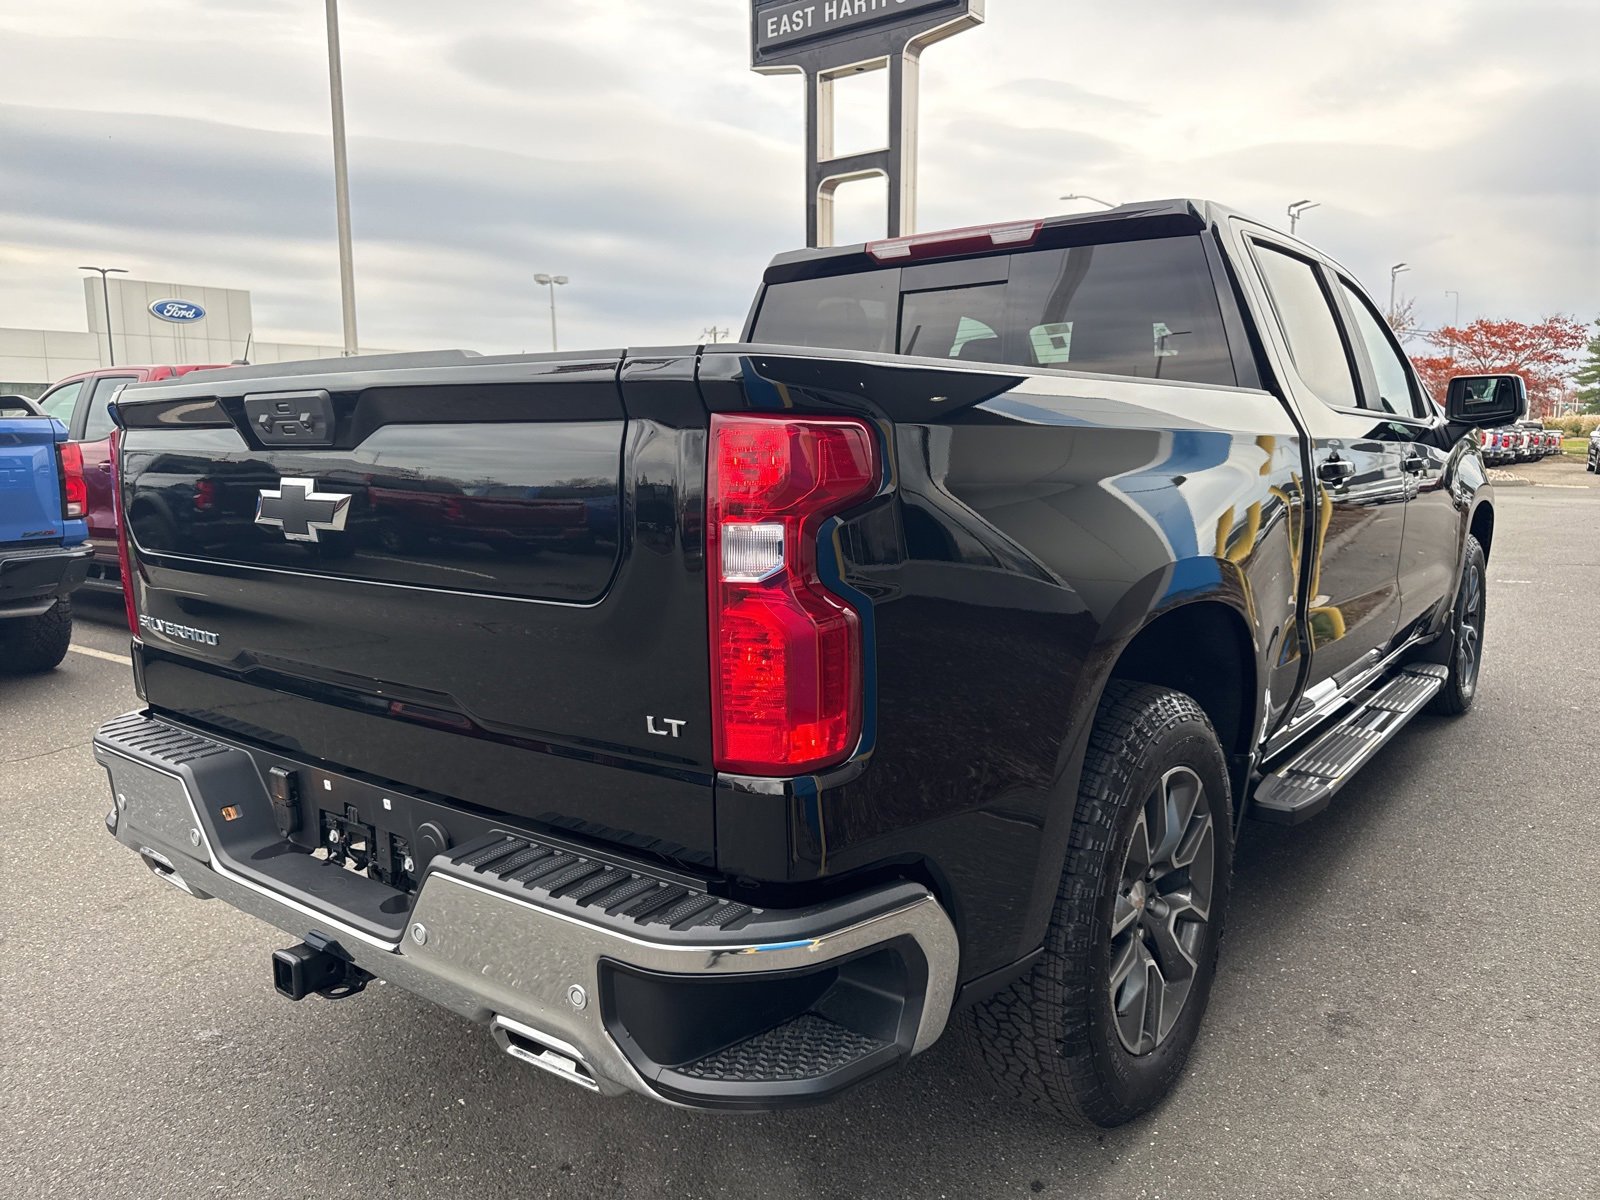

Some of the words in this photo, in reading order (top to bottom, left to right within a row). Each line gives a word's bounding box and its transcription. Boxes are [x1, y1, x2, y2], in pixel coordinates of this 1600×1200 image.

[767, 6, 815, 38] EAST
[825, 0, 907, 23] HAR
[163, 303, 196, 318] Ford
[140, 614, 220, 646] SILVERADO
[646, 715, 687, 738] LT
